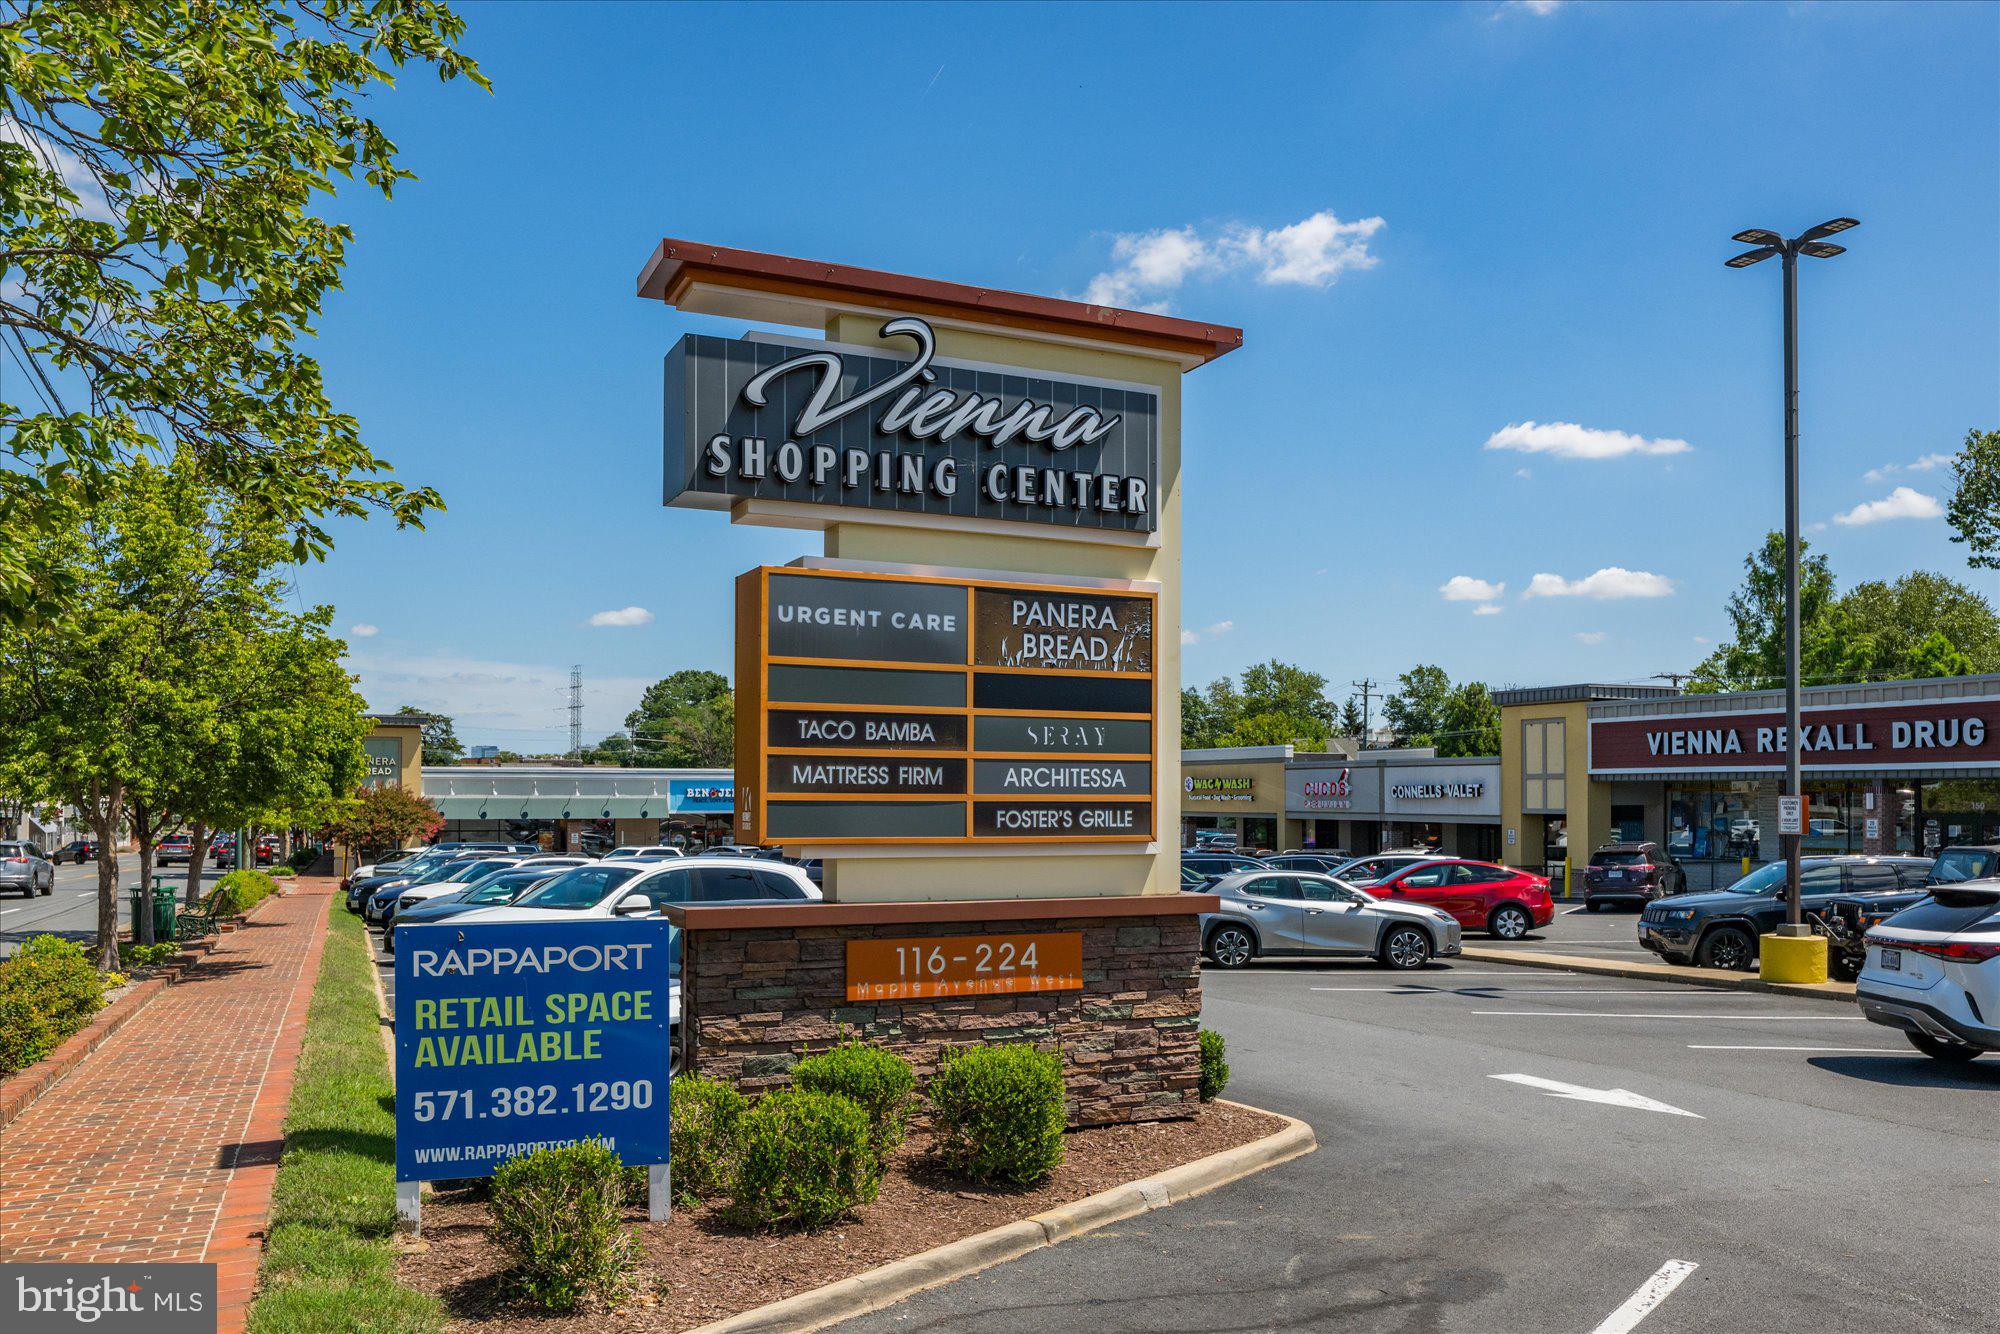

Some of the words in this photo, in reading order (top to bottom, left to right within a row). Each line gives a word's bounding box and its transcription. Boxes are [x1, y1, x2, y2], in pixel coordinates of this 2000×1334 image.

[741, 317, 1121, 451] Vienna
[707, 433, 959, 497] SHOPPING
[986, 463, 1148, 515] CENTER
[777, 605, 881, 628] URGENT
[891, 612, 956, 632] CARE
[1012, 600, 1118, 631] PANERA
[1023, 633, 1108, 661] BREAD
[799, 720, 856, 740] TACO
[865, 721, 936, 742] BAMBA
[1646, 729, 1743, 756] VIENNA
[1757, 723, 1873, 753] REXALL
[1892, 717, 1985, 749] DRUG
[364, 757, 396, 766] NERA
[793, 765, 889, 785] MATTRESS
[900, 766, 943, 786] FIRM
[1004, 767, 1126, 788] ARCHITESSA
[1193, 779, 1214, 789] WAG
[1222, 779, 1250, 789] WASH
[686, 788, 709, 797] BEN
[1391, 784, 1442, 798] CONNELLS
[1446, 784, 1480, 798] VALET
[996, 810, 1072, 828] FOSTER'S
[1079, 810, 1133, 828] GRILLE
[1972, 802, 1985, 810] 150
[413, 943, 652, 977] RAPPAPORT
[896, 942, 1039, 975] 116-224
[857, 980, 922, 994] Maple
[938, 977, 1014, 991] Avenue
[1029, 973, 1073, 986] West
[415, 995, 535, 1030] RETAIL
[545, 990, 652, 1024] SPACE
[414, 1029, 602, 1068] AVAILABLE
[414, 1079, 653, 1122] 571.382.1290
